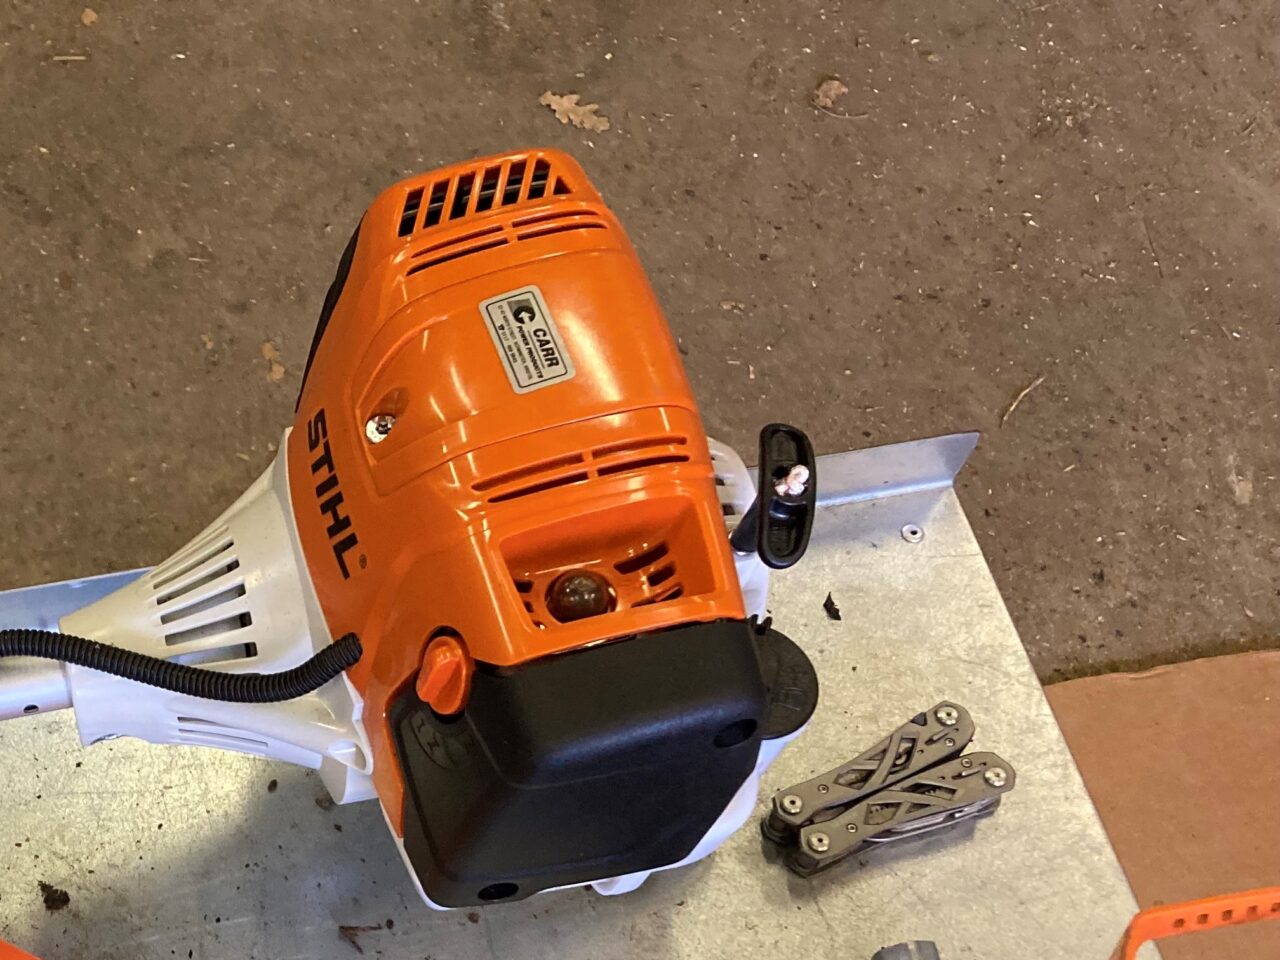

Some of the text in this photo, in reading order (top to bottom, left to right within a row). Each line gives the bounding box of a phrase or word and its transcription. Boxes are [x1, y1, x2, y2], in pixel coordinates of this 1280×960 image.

[516, 326, 543, 379] POWER PRODUCTS
[533, 328, 560, 368] CARR
[307, 408, 358, 579] STIHL
